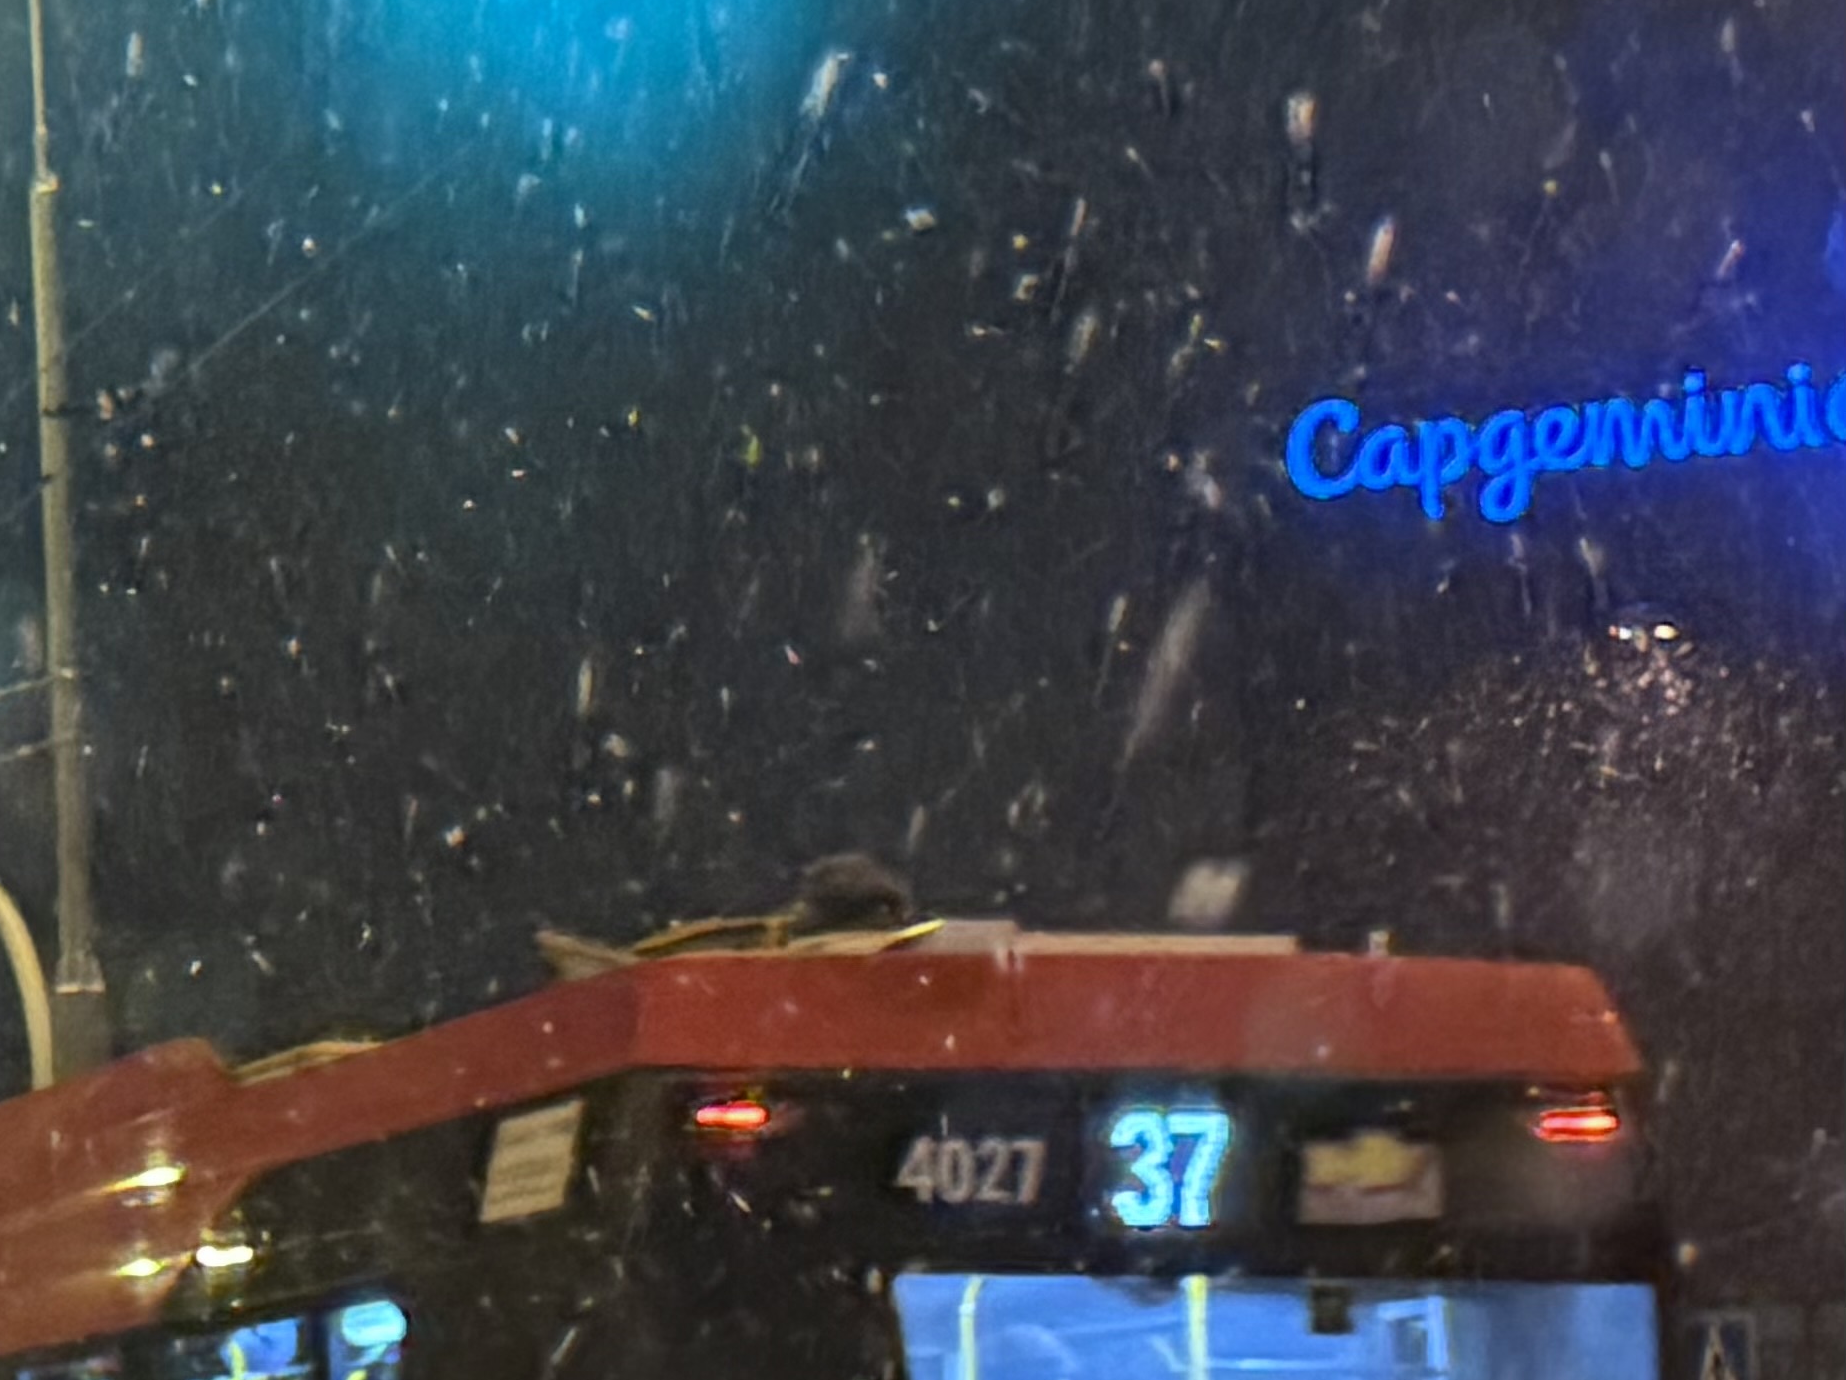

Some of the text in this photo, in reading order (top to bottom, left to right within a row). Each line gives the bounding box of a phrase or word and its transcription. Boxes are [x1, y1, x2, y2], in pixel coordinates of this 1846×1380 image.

[1286, 362, 1830, 523] Capgemini
[895, 1135, 1046, 1204] 4027
[1110, 1109, 1230, 1228] 37
